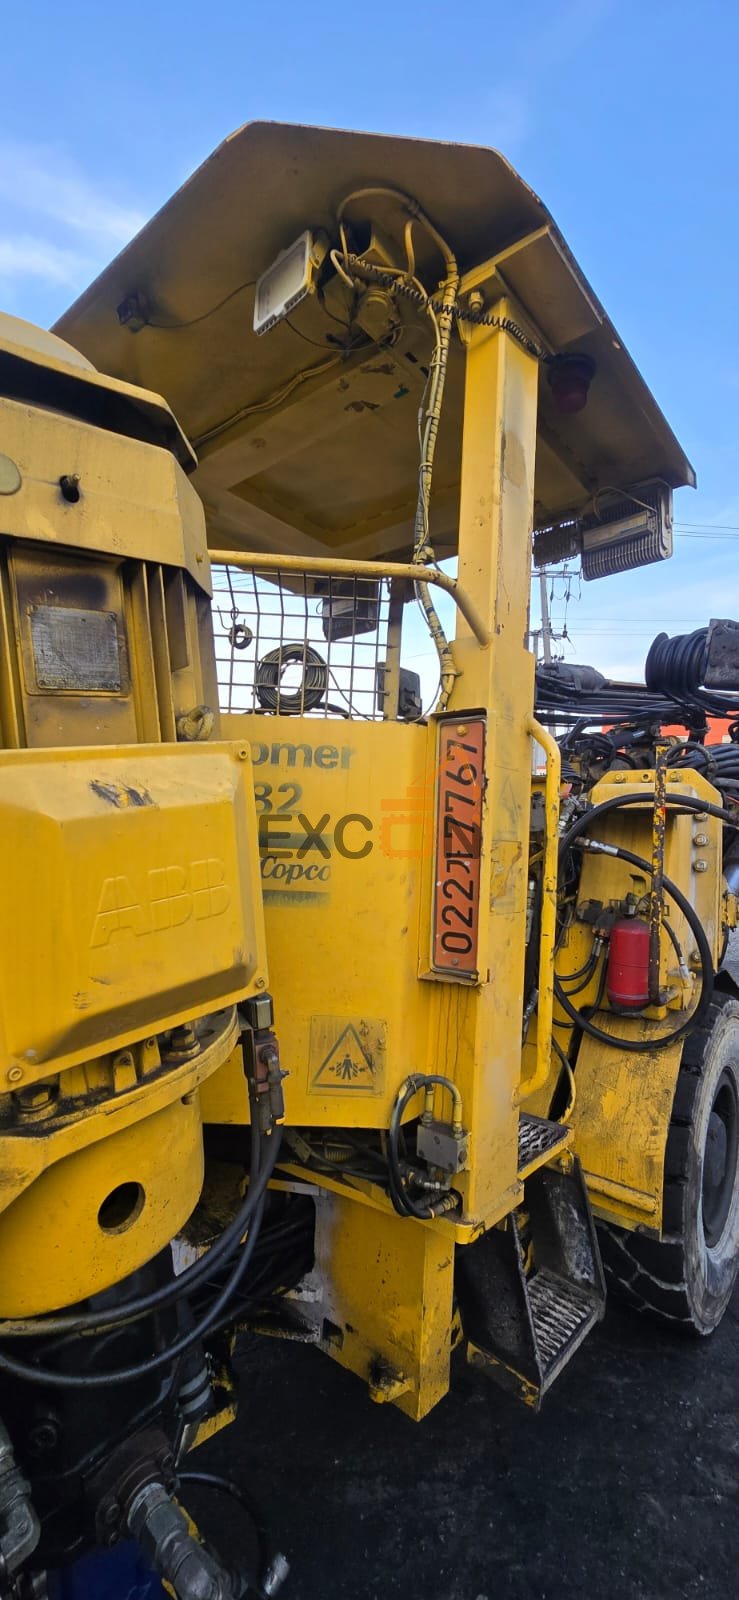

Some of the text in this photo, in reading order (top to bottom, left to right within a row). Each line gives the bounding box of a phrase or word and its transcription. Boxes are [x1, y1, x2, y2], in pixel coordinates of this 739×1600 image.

[251, 741, 354, 769] omer
[254, 782, 303, 815] 82
[260, 855, 331, 885] Copco
[90, 858, 231, 950] ABB
